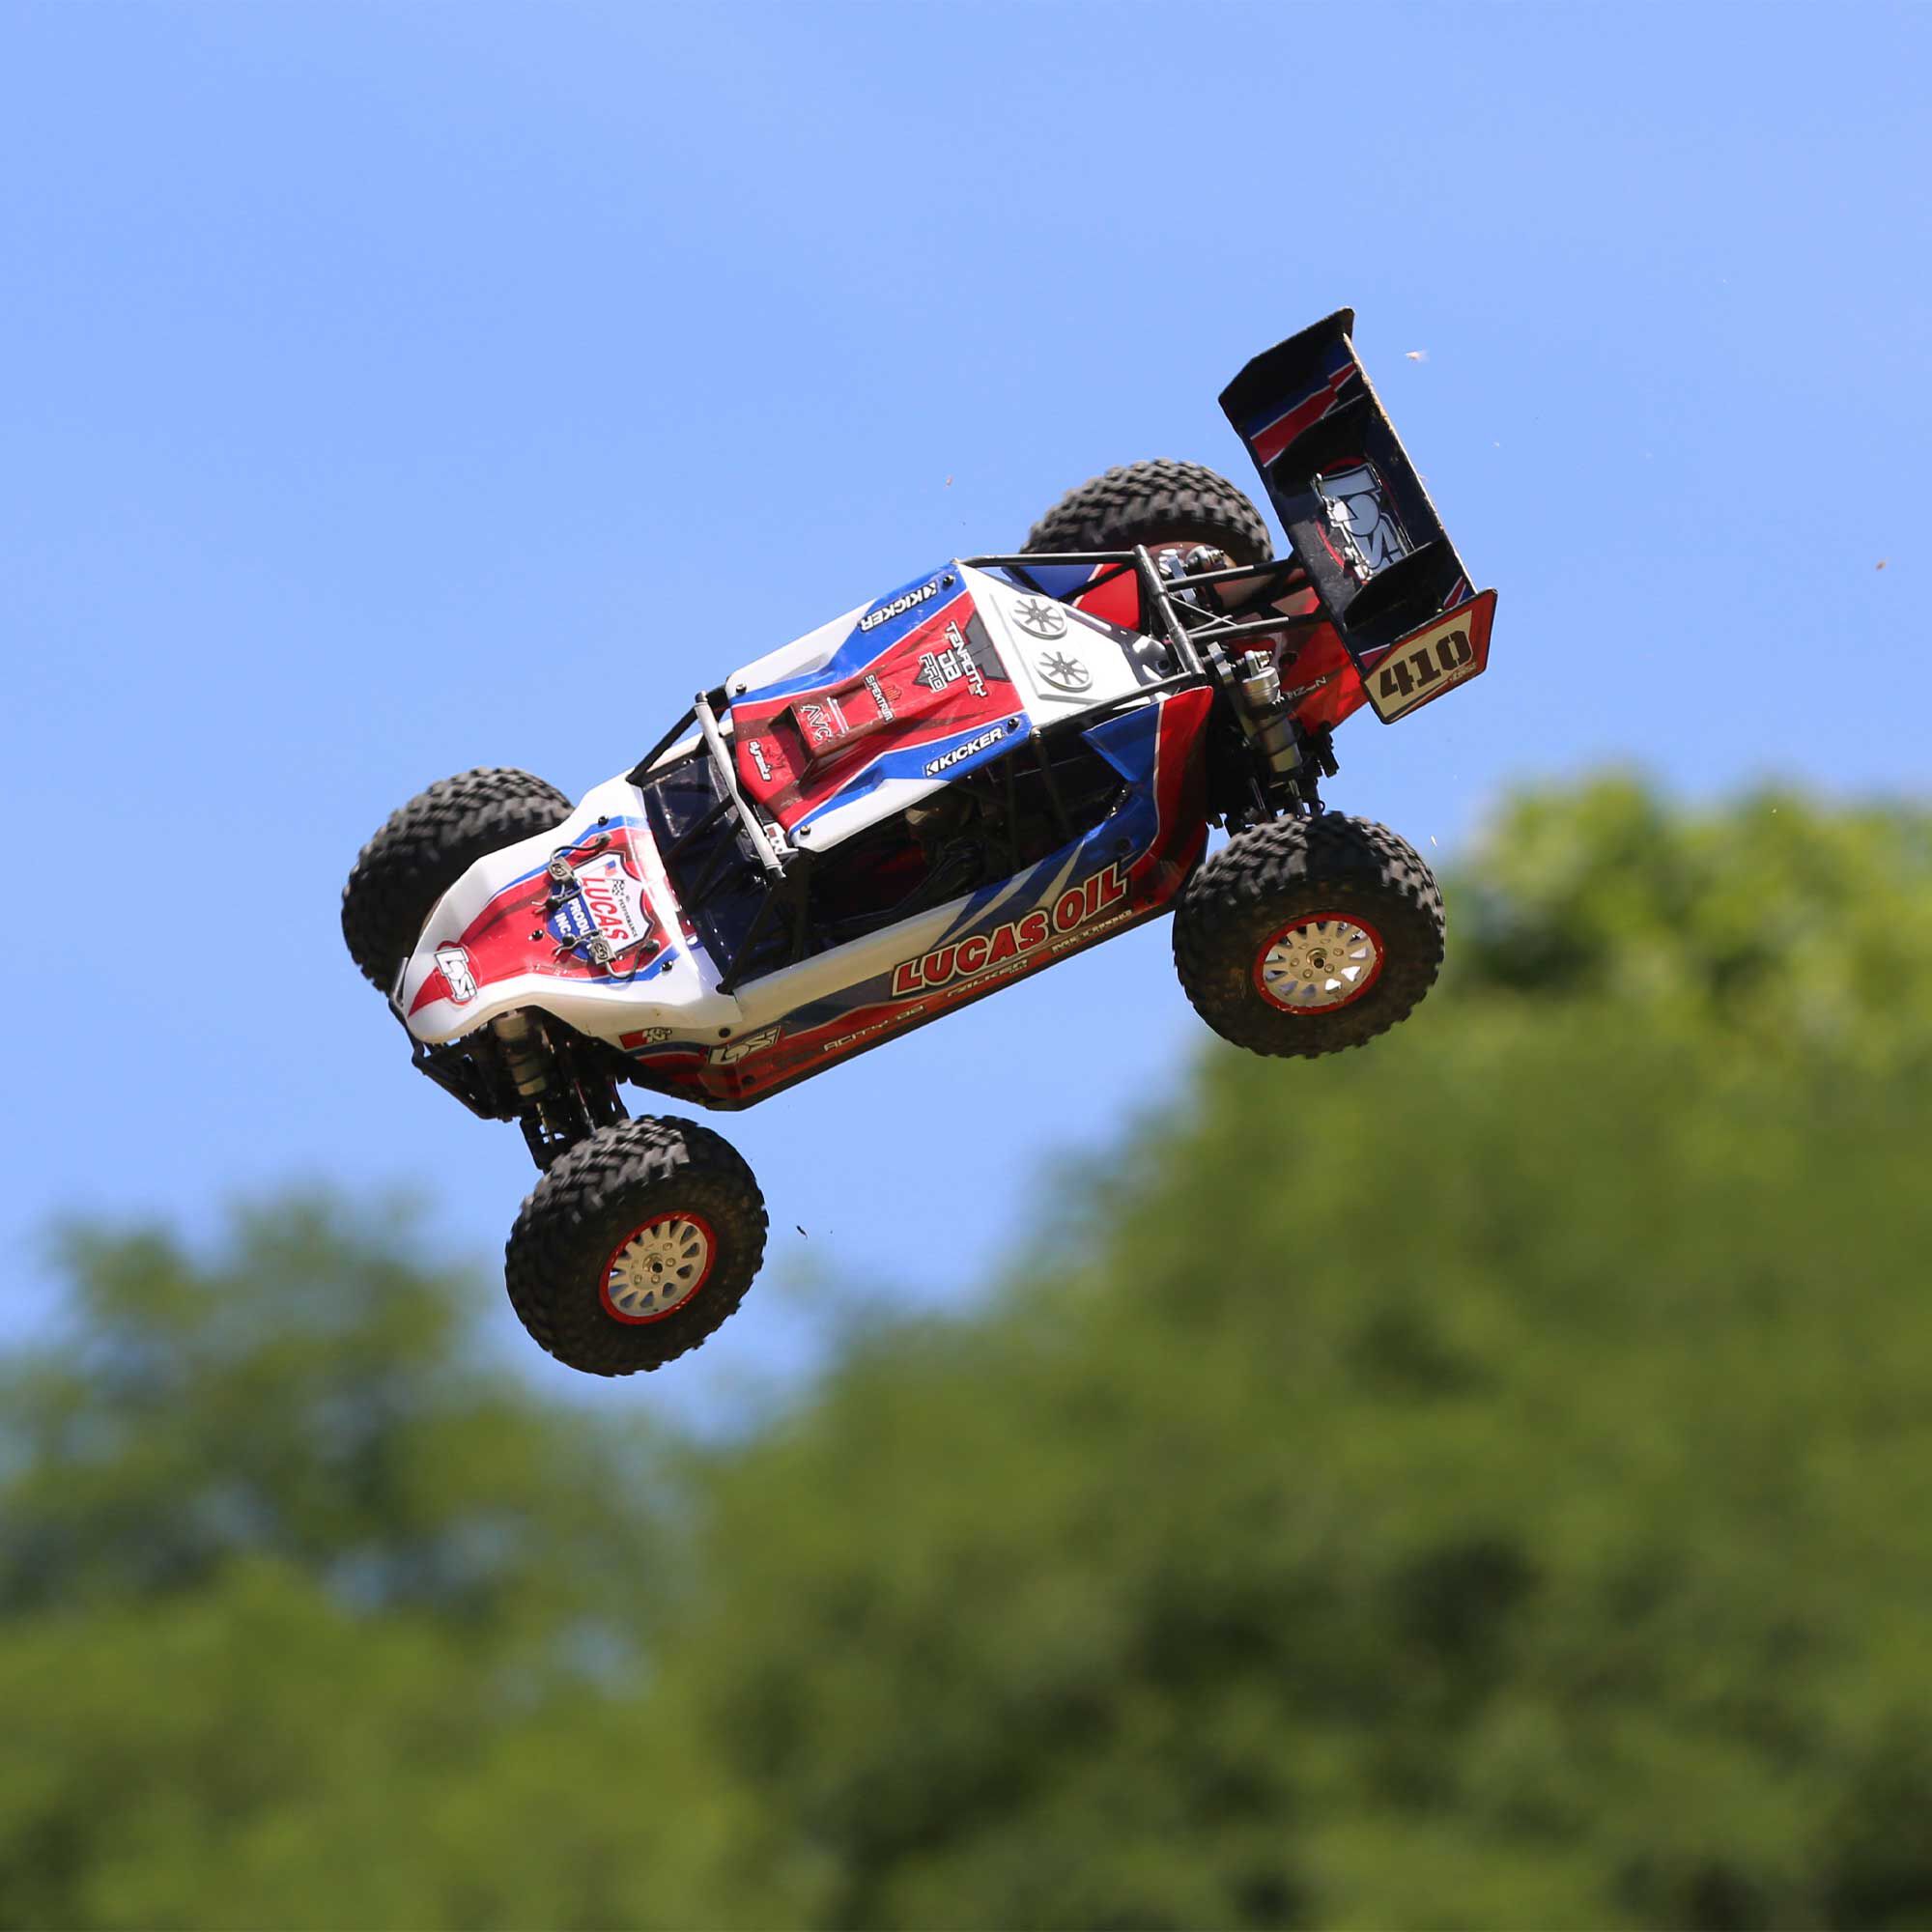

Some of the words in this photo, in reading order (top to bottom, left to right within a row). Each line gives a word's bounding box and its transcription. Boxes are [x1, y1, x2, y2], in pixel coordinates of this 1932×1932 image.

[860, 584, 928, 633] KICKER
[918, 651, 948, 694] PRO
[945, 620, 988, 697] TENACITY
[1379, 630, 1474, 698] 410
[937, 726, 1005, 771] KICKER
[581, 877, 630, 941] LUCAS
[891, 909, 1049, 997] LUCAS
[1052, 862, 1128, 934] OIL
